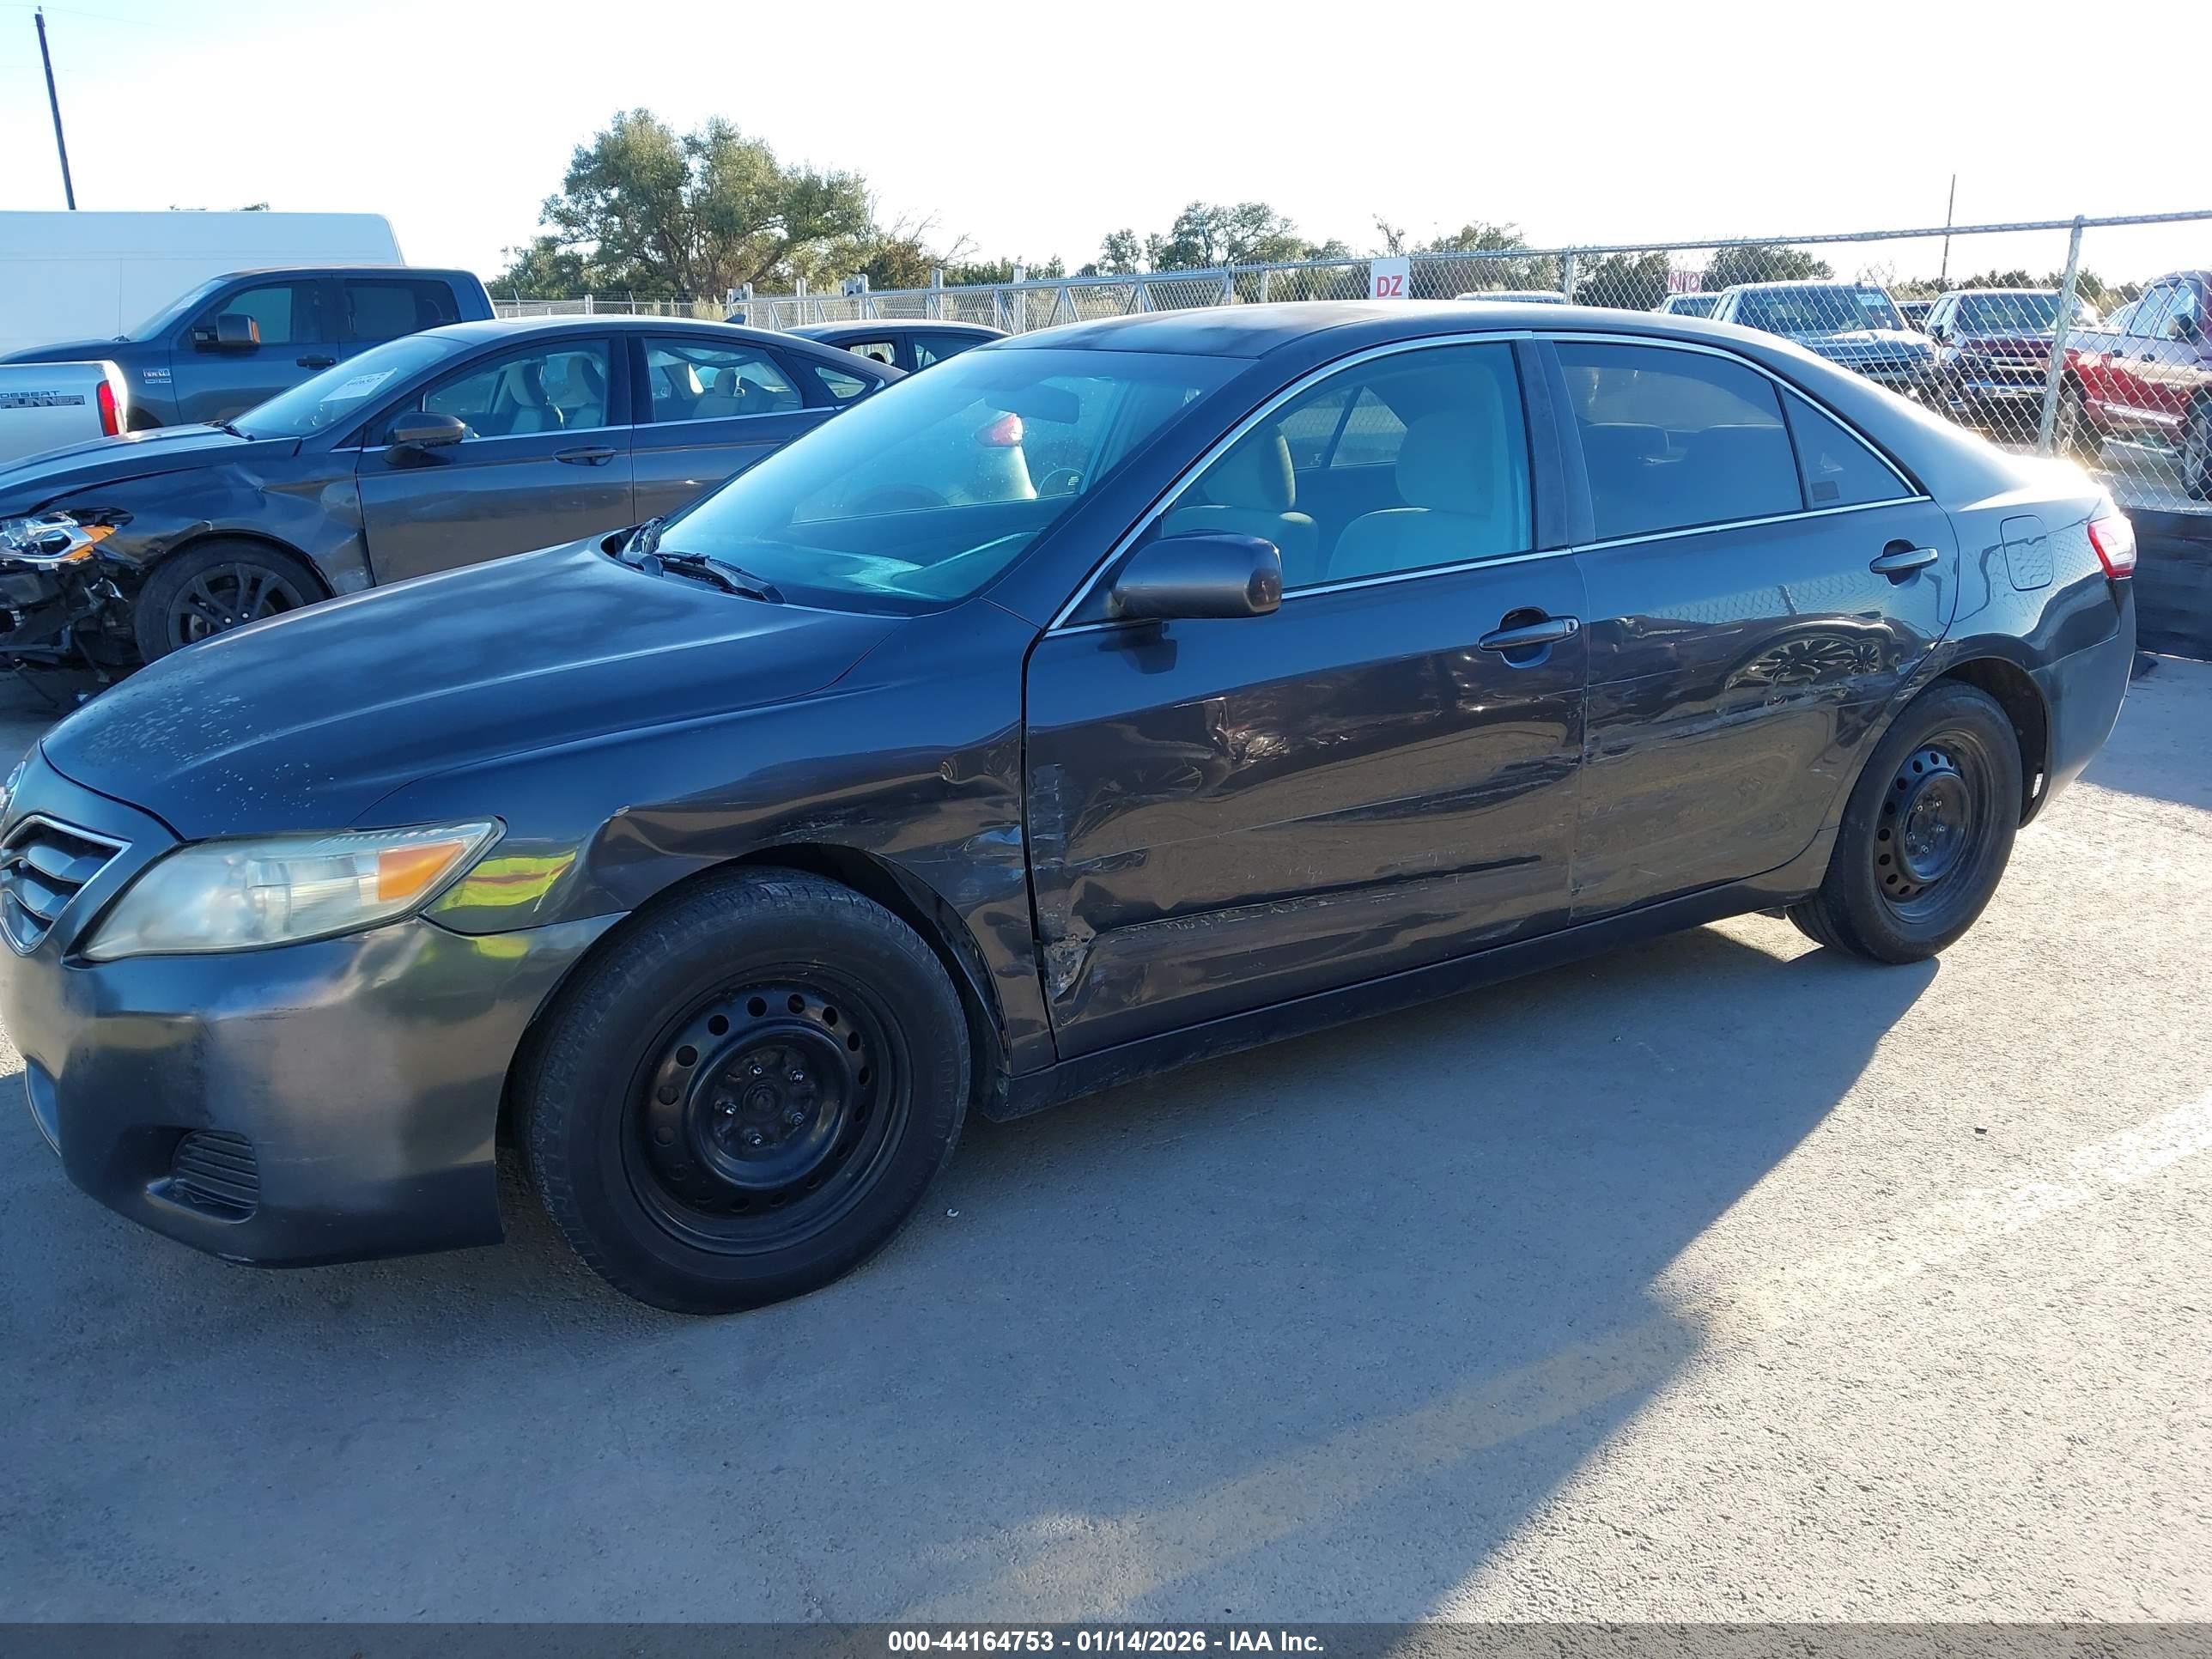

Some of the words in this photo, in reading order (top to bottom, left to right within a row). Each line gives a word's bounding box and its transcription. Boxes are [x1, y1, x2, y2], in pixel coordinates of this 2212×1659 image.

[1376, 275, 1403, 298] DZ
[0, 390, 61, 398] DESERT
[0, 395, 85, 409] RUNNER
